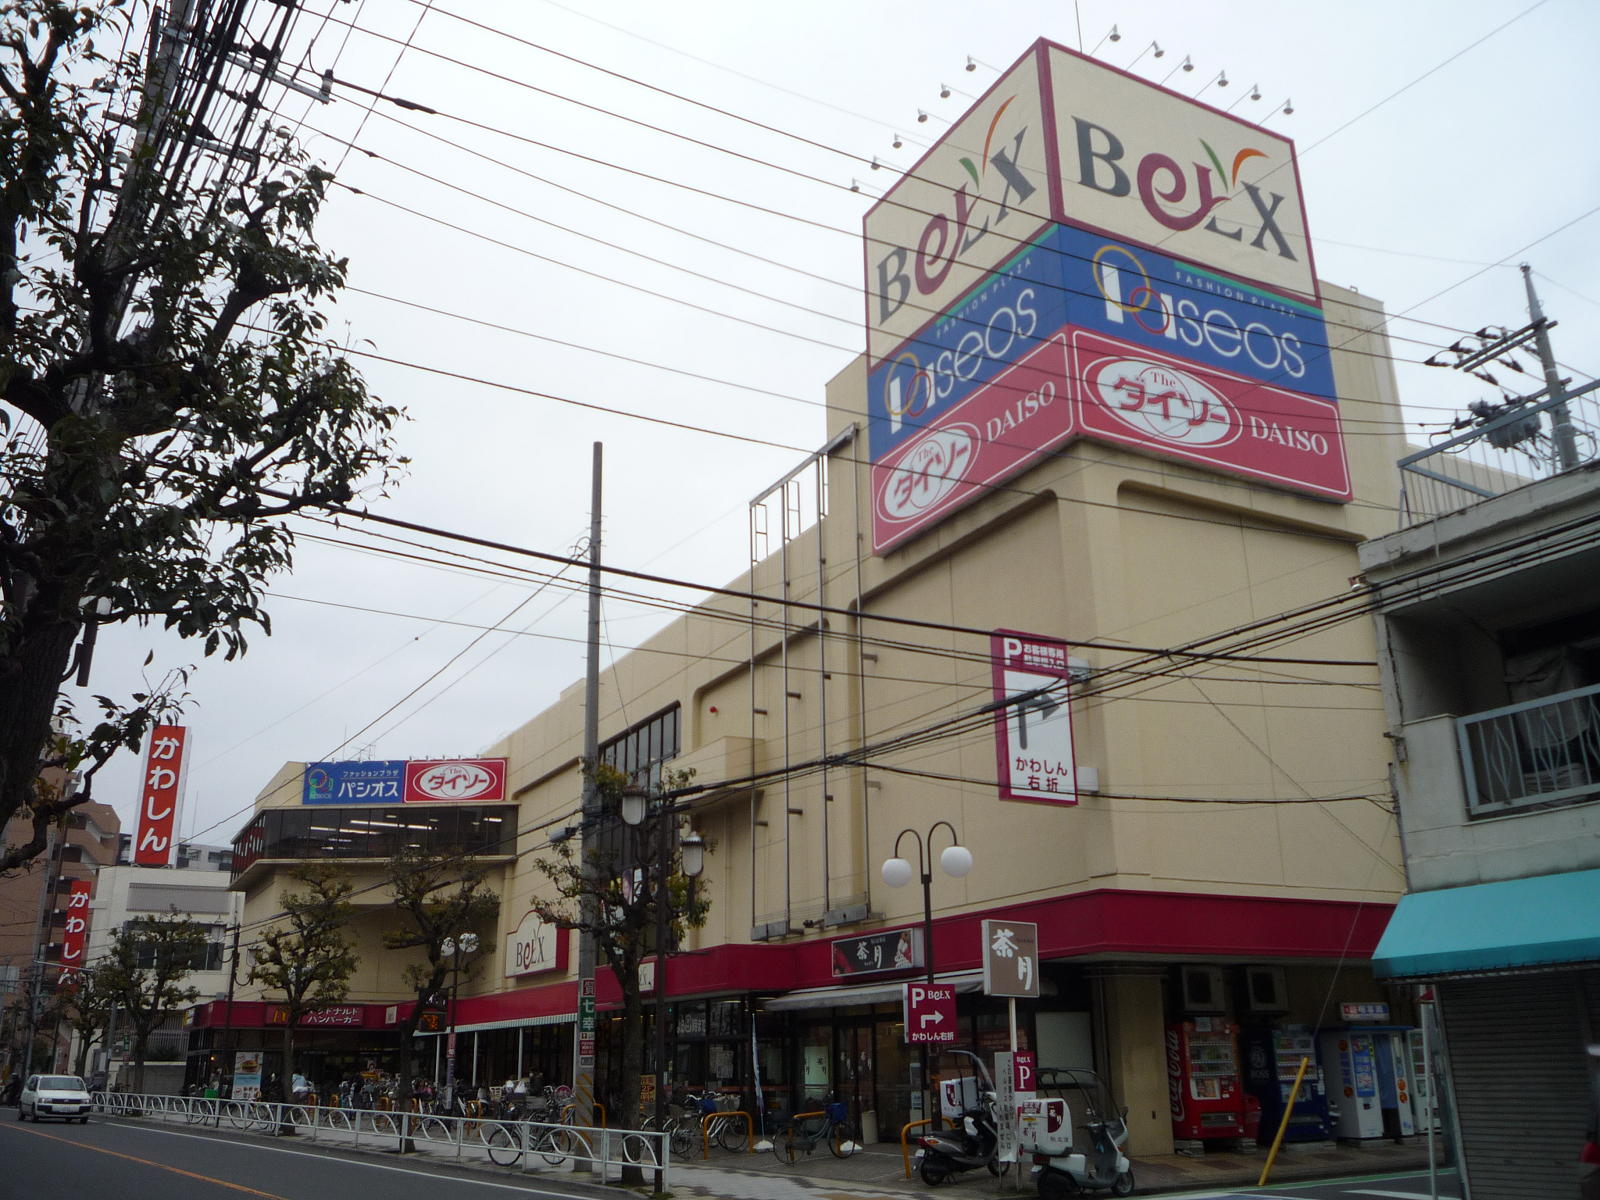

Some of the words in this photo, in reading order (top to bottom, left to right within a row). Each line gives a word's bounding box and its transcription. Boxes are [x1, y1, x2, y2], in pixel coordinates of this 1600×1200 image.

[1175, 271, 1245, 301] FASHION
[1150, 370, 1177, 388] The
[985, 380, 1056, 442] DAISO
[1113, 376, 1227, 427] ダイソー
[1249, 415, 1329, 456] DAISO
[894, 441, 969, 510] ダイソー
[1004, 637, 1023, 666] P
[1016, 756, 1068, 777] かわしん
[337, 781, 399, 798] パシオス
[428, 772, 487, 790] ダイソー
[1027, 774, 1059, 793] 右折
[139, 736, 180, 853] かわしん
[856, 941, 883, 969] 茶月
[991, 928, 1033, 992] 茶月
[911, 987, 925, 1009] P
[307, 1016, 360, 1024] ハンバーガー
[911, 1031, 954, 1041] かわしん右折
[1018, 1065, 1030, 1089] P
